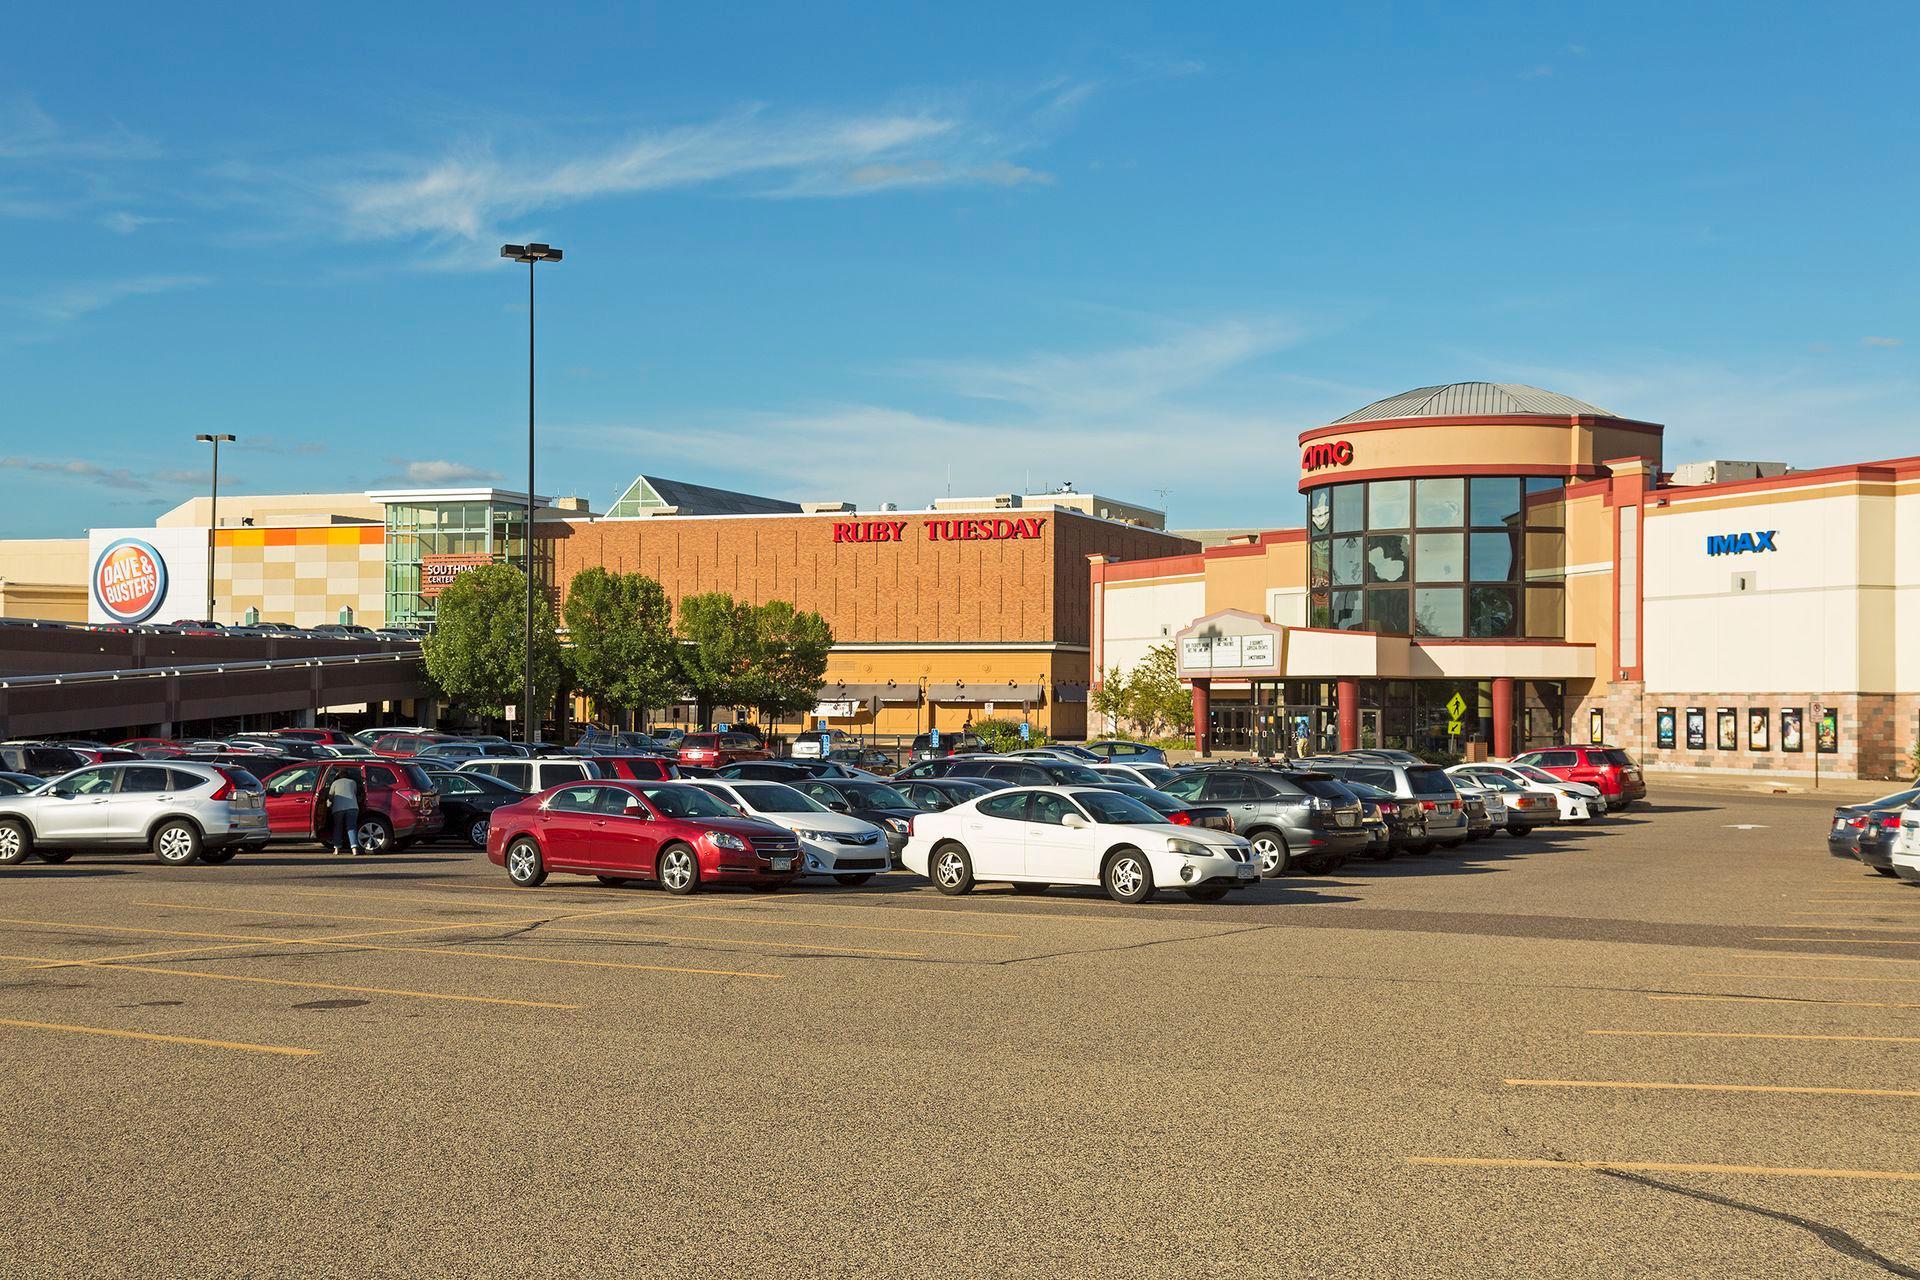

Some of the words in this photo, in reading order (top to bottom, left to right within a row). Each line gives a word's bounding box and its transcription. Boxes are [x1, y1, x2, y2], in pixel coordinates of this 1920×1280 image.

[832, 521, 906, 543] RUBY
[924, 518, 1047, 541] TUESDAY
[1707, 530, 1777, 556] IMAX
[104, 557, 142, 587] DAVE
[139, 555, 154, 575] &
[427, 564, 482, 575] SOUTHDA
[427, 575, 454, 584] CENTER
[105, 574, 156, 604] BUSTER'S
